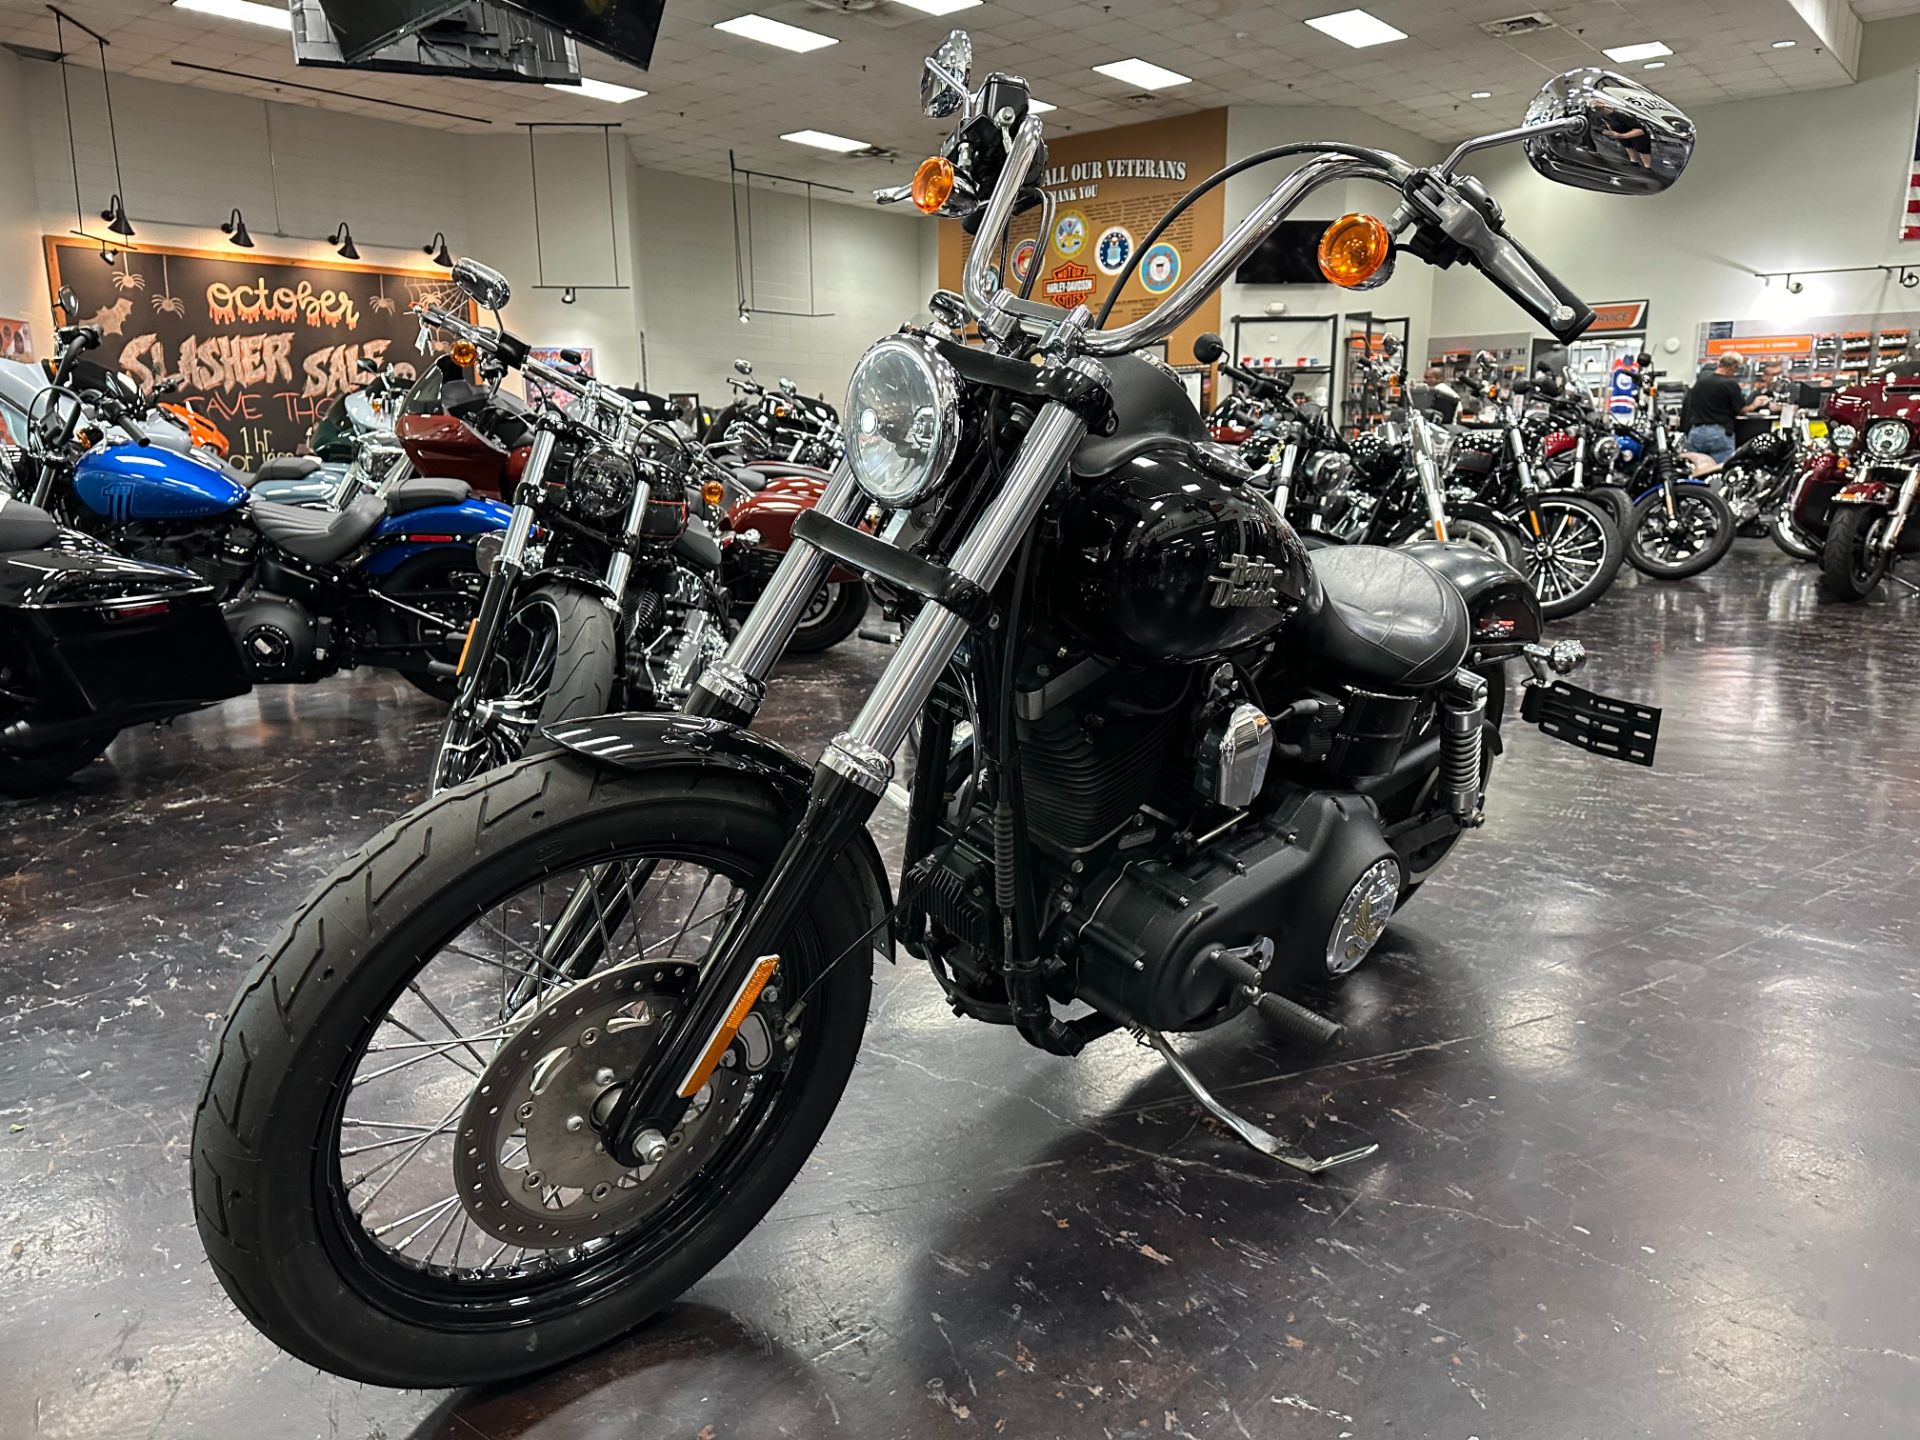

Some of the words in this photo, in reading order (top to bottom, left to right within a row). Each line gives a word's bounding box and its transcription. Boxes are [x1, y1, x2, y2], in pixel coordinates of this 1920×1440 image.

[1041, 166, 1069, 187] ALL
[1071, 161, 1103, 181] OUR
[1106, 159, 1187, 181] VETERANS
[1051, 188, 1077, 203] HANK
[1079, 184, 1099, 199] YOU
[206, 277, 360, 330] october
[118, 332, 296, 395] SLASHER
[302, 339, 392, 397] SALE
[240, 427, 250, 454] 1
